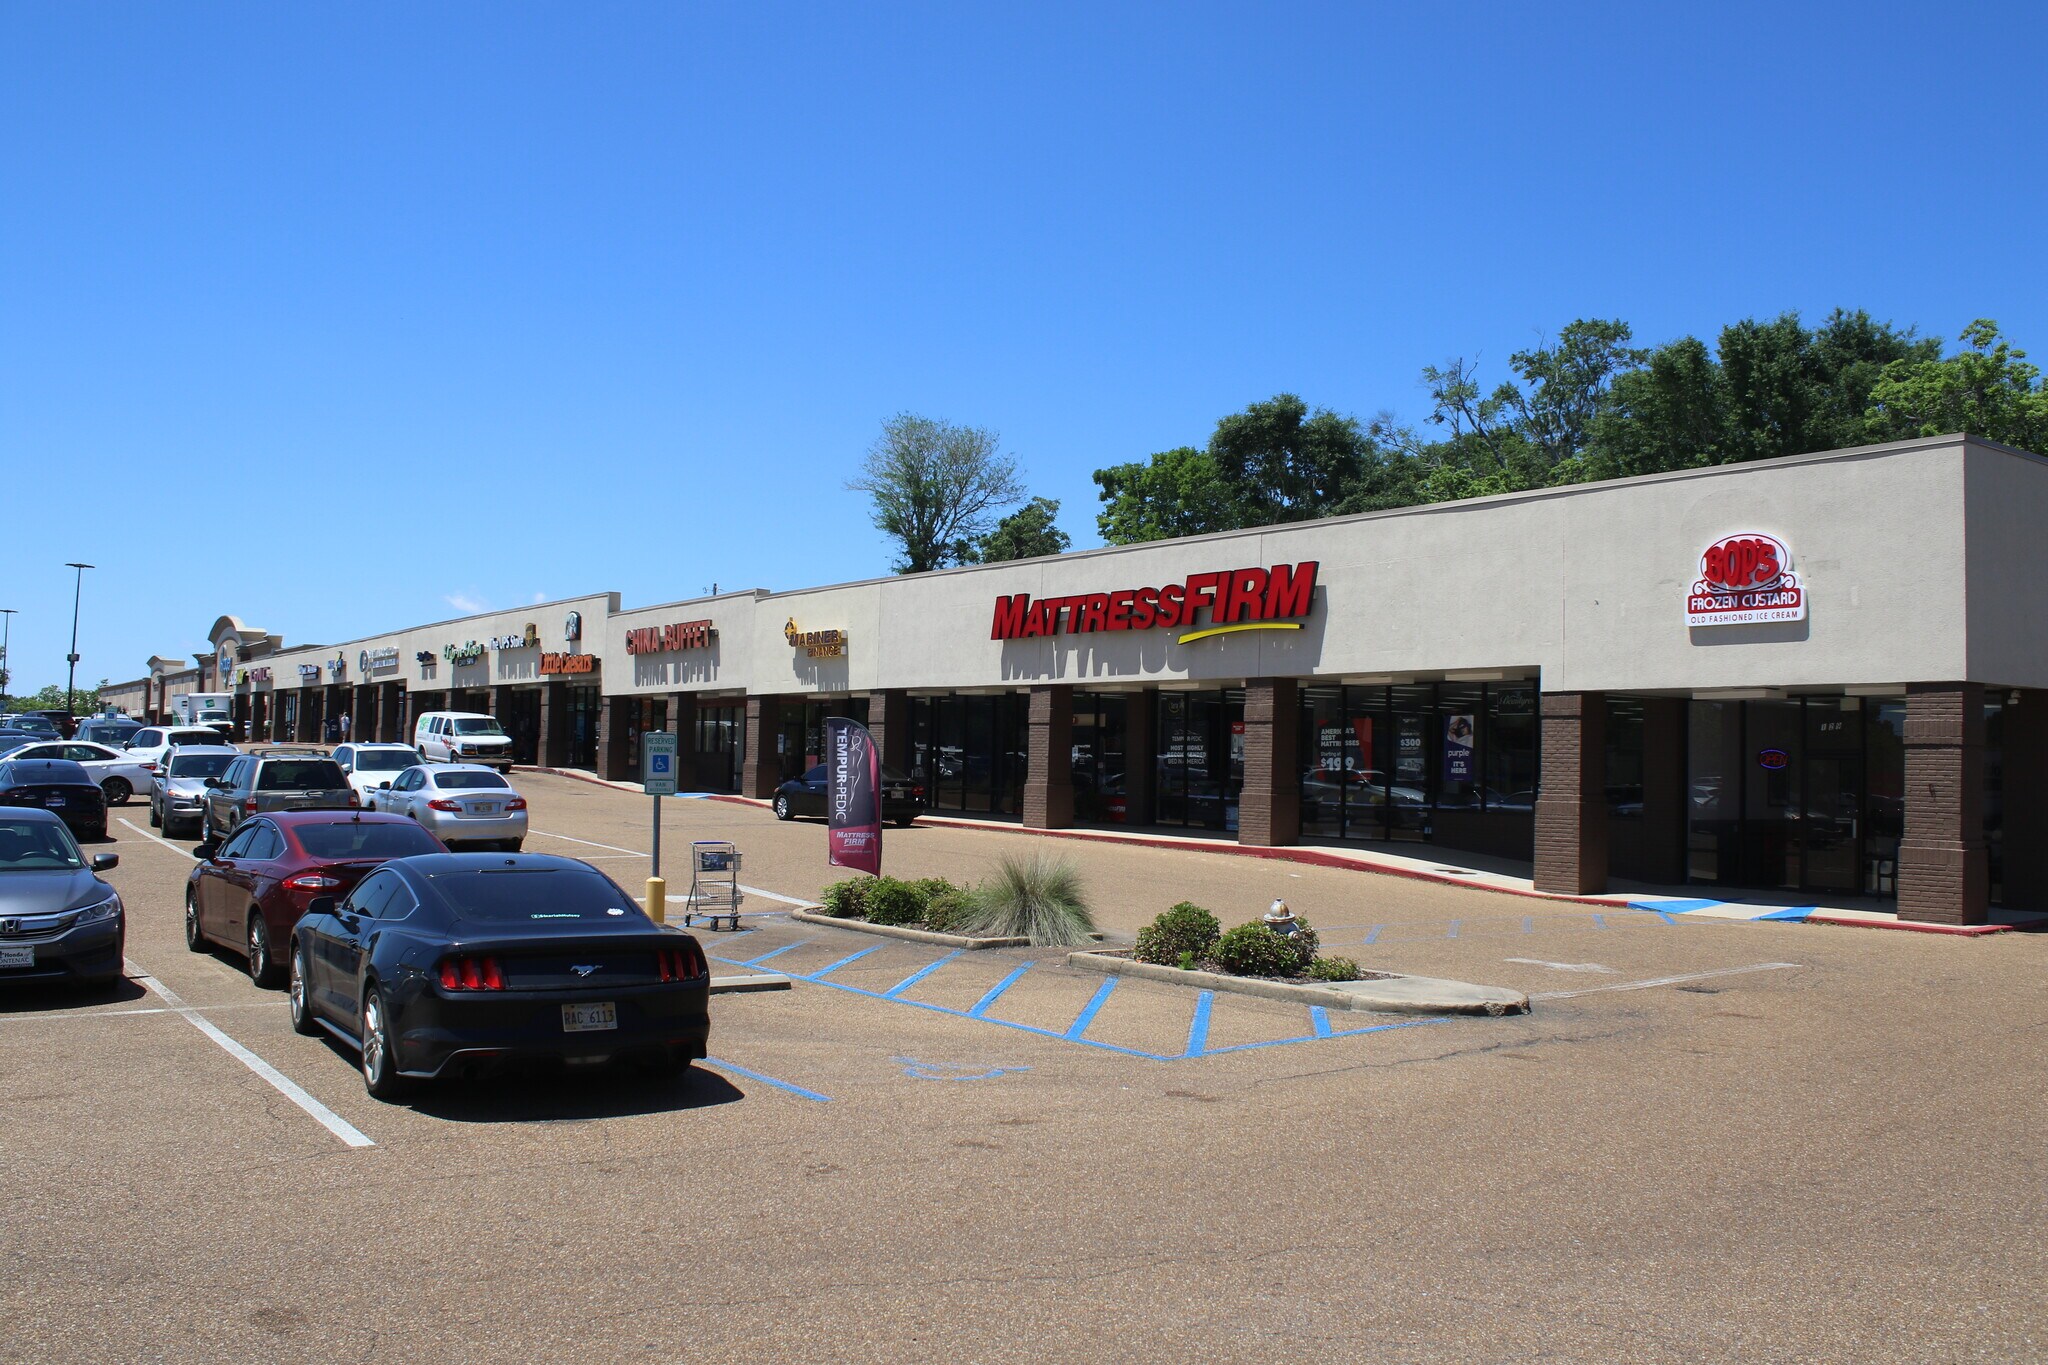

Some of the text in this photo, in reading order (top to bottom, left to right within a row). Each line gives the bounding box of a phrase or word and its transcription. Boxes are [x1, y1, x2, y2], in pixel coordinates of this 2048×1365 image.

[1704, 538, 1779, 586] BOP'S
[1691, 591, 1797, 611] FROZEN CUSTARD
[1691, 616, 1706, 624] OLD
[1709, 613, 1753, 623] FASHIONED
[1771, 611, 1798, 619] CREAM
[626, 619, 713, 655] CHINA BUFFET
[789, 629, 840, 647] MARINER
[647, 737, 675, 745] RESERVED
[1400, 738, 1420, 747] $300
[1447, 749, 1470, 758] purple
[1760, 753, 1788, 766] OPEN
[836, 727, 847, 820] TEMPUR-PEDIC
[836, 831, 875, 839] MATTRESS
[564, 1009, 614, 1025] RAC 6113
